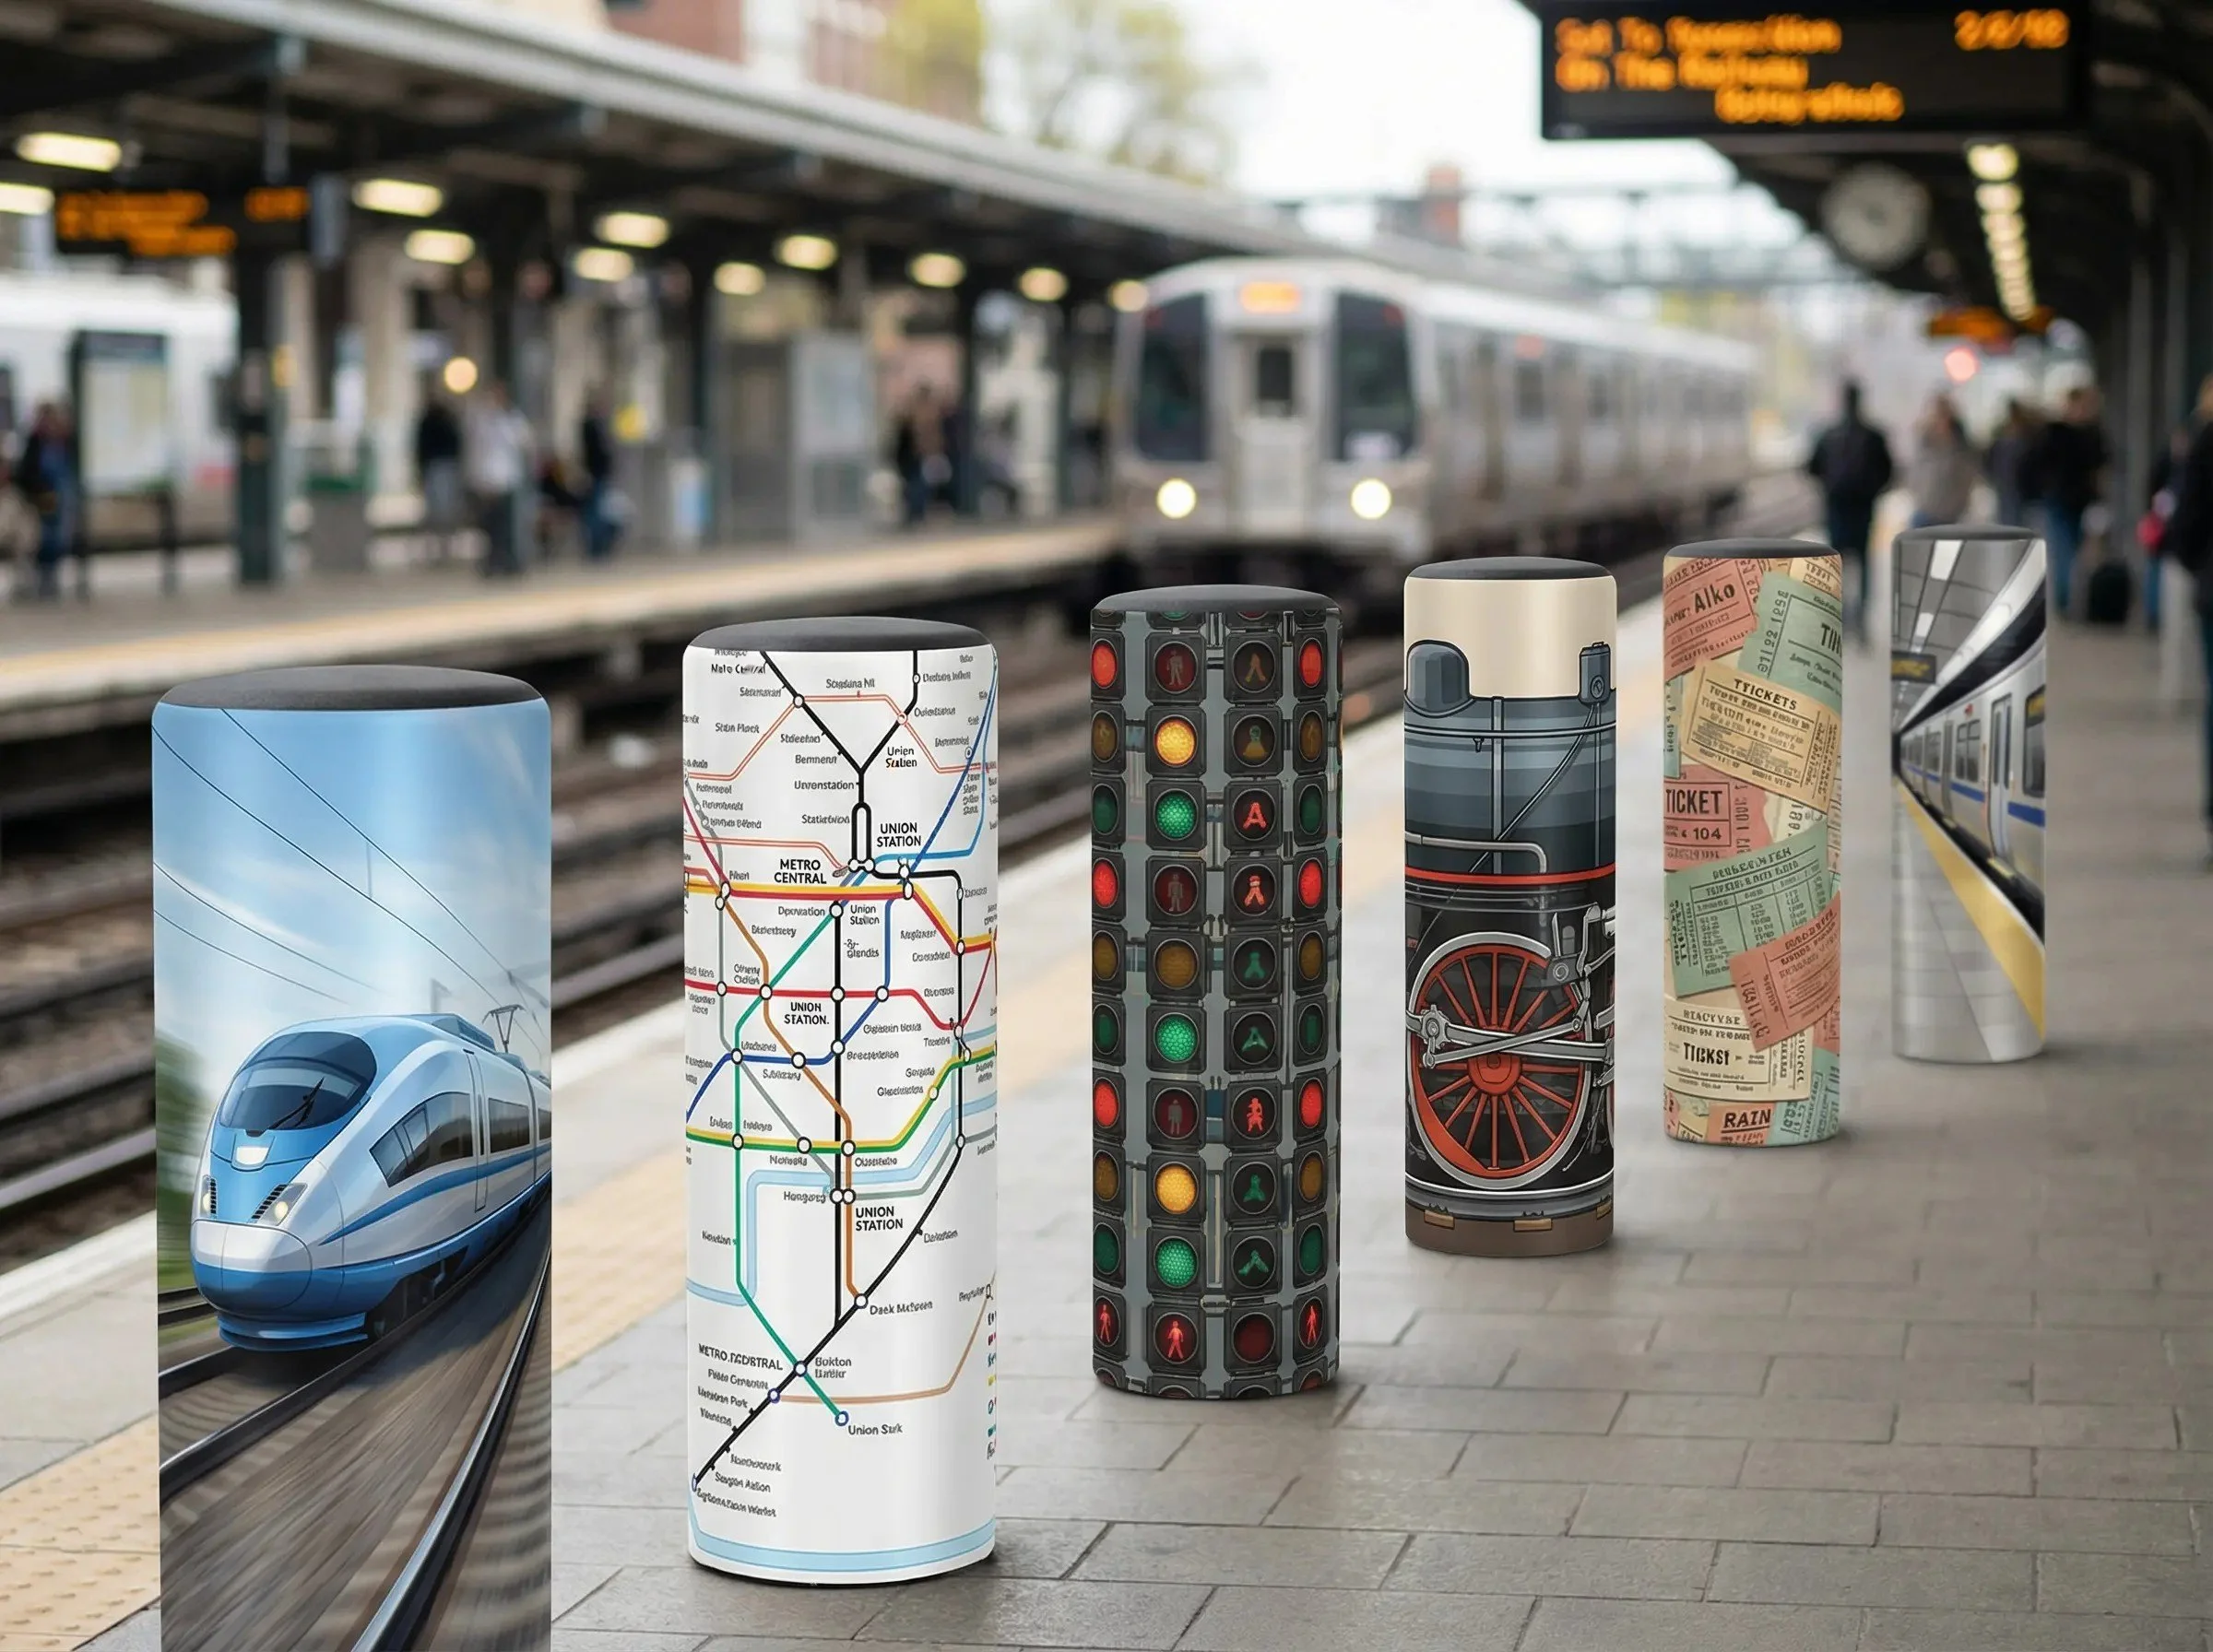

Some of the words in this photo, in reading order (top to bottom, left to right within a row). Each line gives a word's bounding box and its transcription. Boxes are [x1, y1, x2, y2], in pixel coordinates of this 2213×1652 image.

[1664, 788, 1723, 815] TICKET
[880, 821, 917, 834] UNION
[876, 834, 921, 848] STATION
[779, 858, 821, 870] METRO
[774, 871, 827, 884] CENTRAL
[1723, 1109, 1772, 1129] RAIN
[855, 1206, 894, 1219] UNION
[855, 1218, 904, 1232] STATION
[847, 1424, 879, 1435] Union
